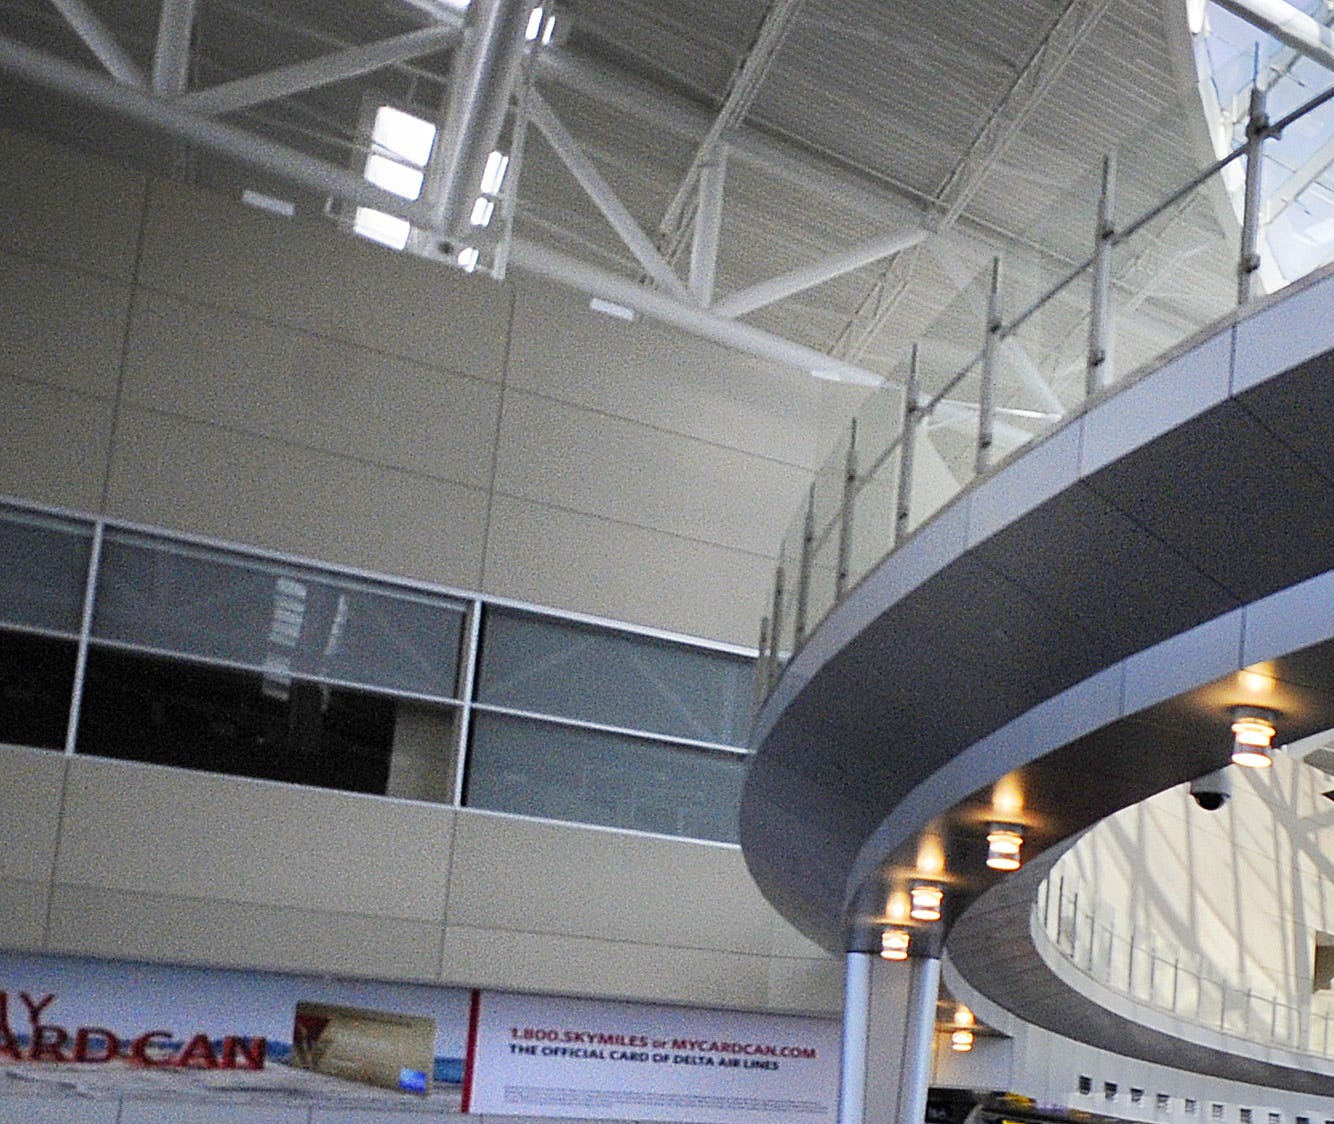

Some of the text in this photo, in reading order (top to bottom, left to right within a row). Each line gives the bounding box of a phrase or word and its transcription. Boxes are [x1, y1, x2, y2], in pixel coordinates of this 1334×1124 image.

[0, 990, 55, 1032] Y
[129, 1030, 267, 1070] CAN
[510, 1028, 817, 1058] 1.800.SKYMILES or MYCARDCAN.COM
[510, 1043, 780, 1071] THE OFFICIAL CARD OF DELTA AIR LINES
